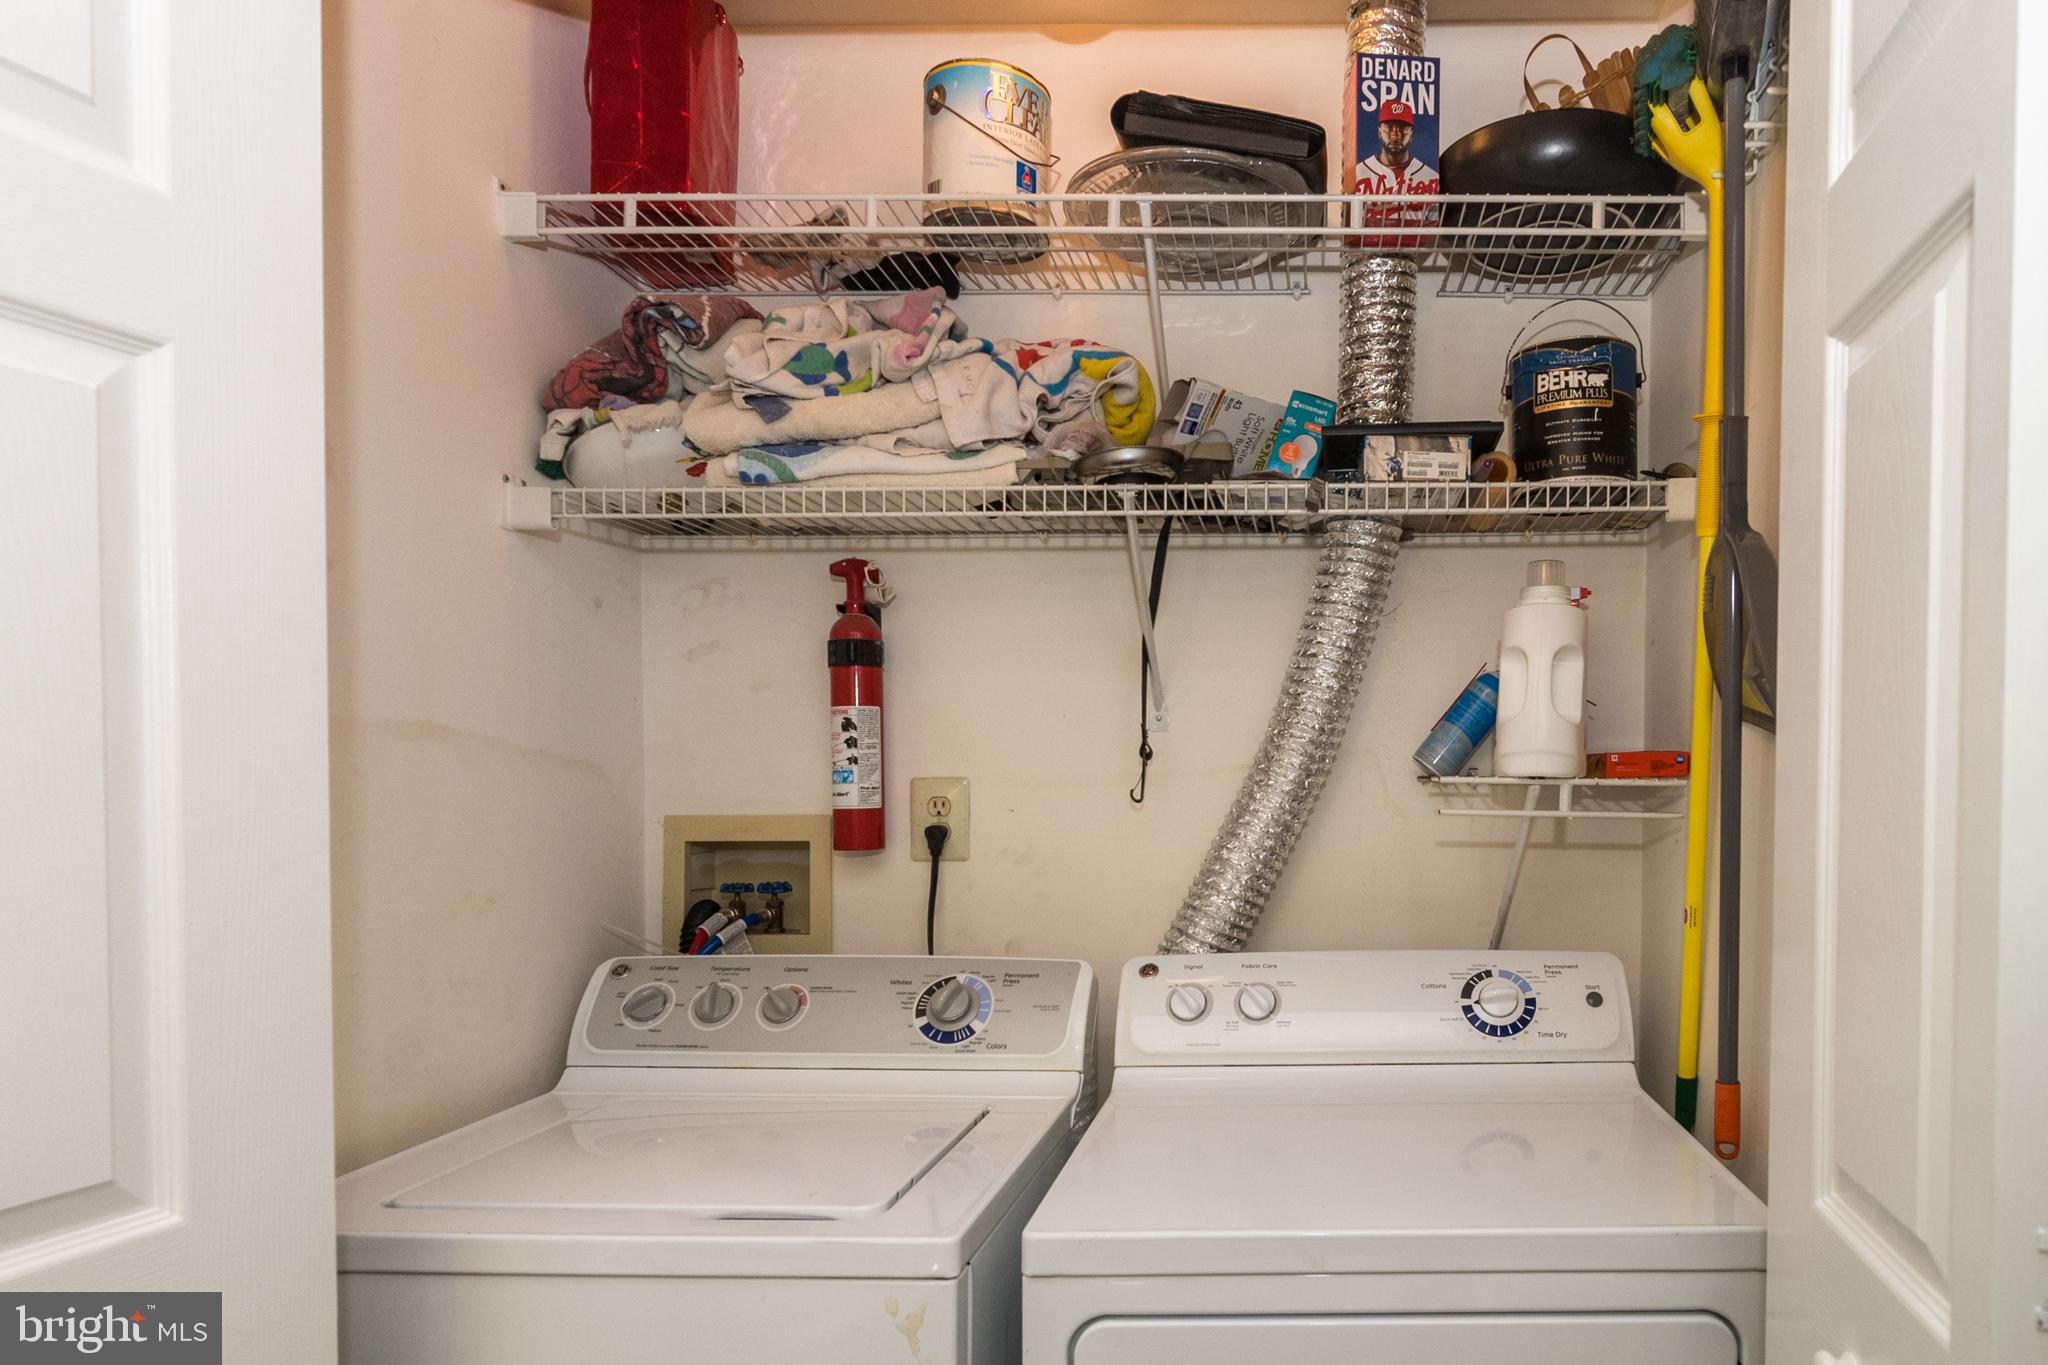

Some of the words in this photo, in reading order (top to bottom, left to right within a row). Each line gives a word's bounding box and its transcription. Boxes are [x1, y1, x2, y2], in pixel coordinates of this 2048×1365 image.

[1361, 57, 1435, 82] DENARD
[1360, 80, 1435, 116] SPAN
[1537, 370, 1588, 394] BEHR
[1537, 389, 1582, 405] PREMIUM
[1585, 388, 1608, 399] PLUS
[1239, 412, 1256, 437] Light
[1252, 415, 1266, 436] Soft
[1236, 437, 1256, 464] White
[1524, 458, 1554, 473] ULTRA
[1559, 453, 1588, 465] PURE
[1592, 452, 1625, 466] WHITE
[710, 966, 751, 974] Temperature
[783, 966, 809, 974] Options
[1183, 963, 1204, 971] Signal
[1584, 983, 1600, 991] Start
[1554, 1031, 1568, 1040] Dry
[986, 1042, 1007, 1050] Colors
